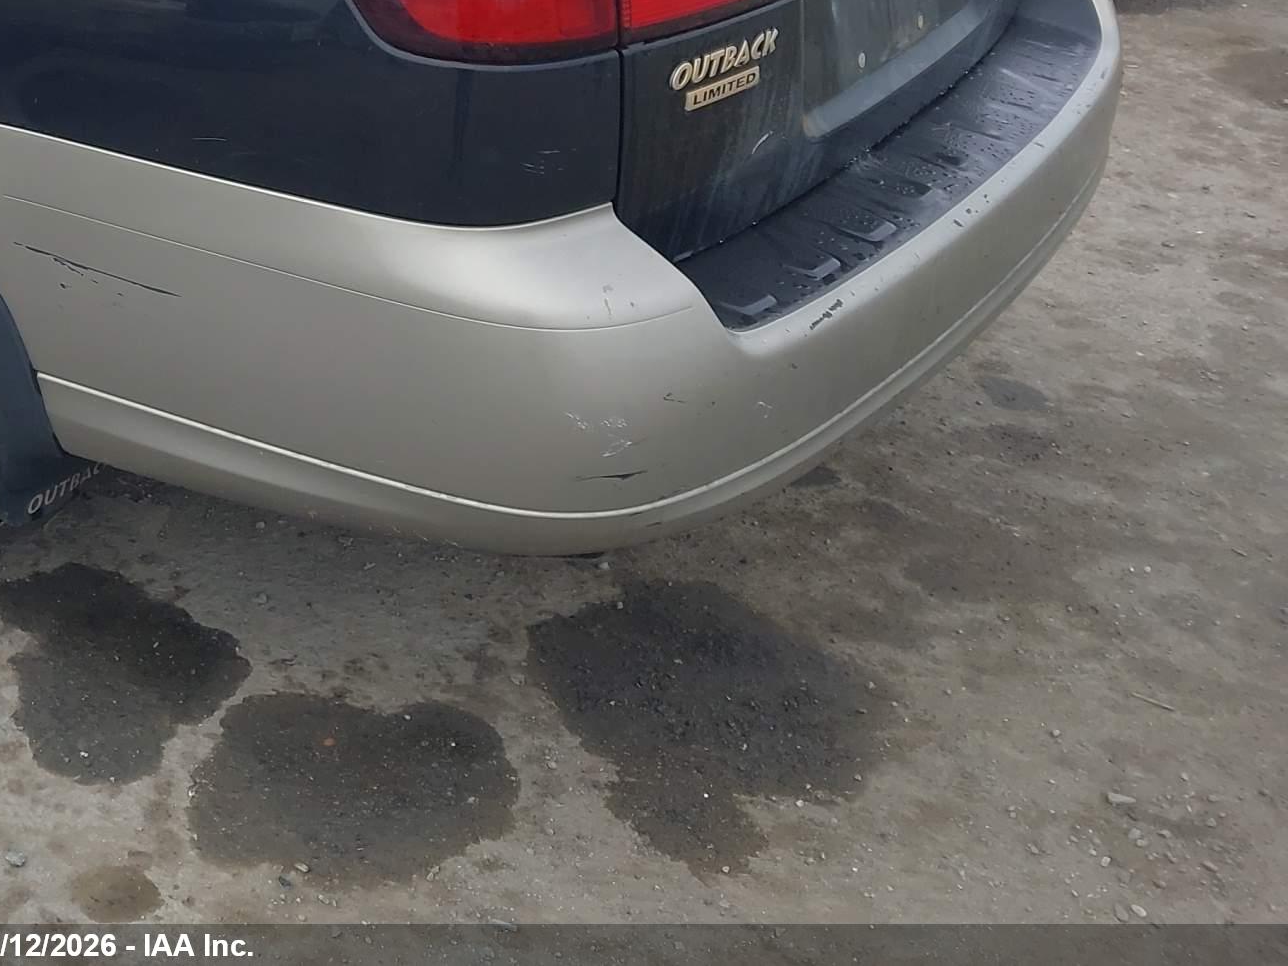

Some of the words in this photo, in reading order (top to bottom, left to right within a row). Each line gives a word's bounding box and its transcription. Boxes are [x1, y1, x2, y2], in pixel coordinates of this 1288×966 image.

[669, 27, 779, 91] OUTBACK
[693, 72, 757, 106] LIMITED
[27, 462, 105, 515] OUTBAC
